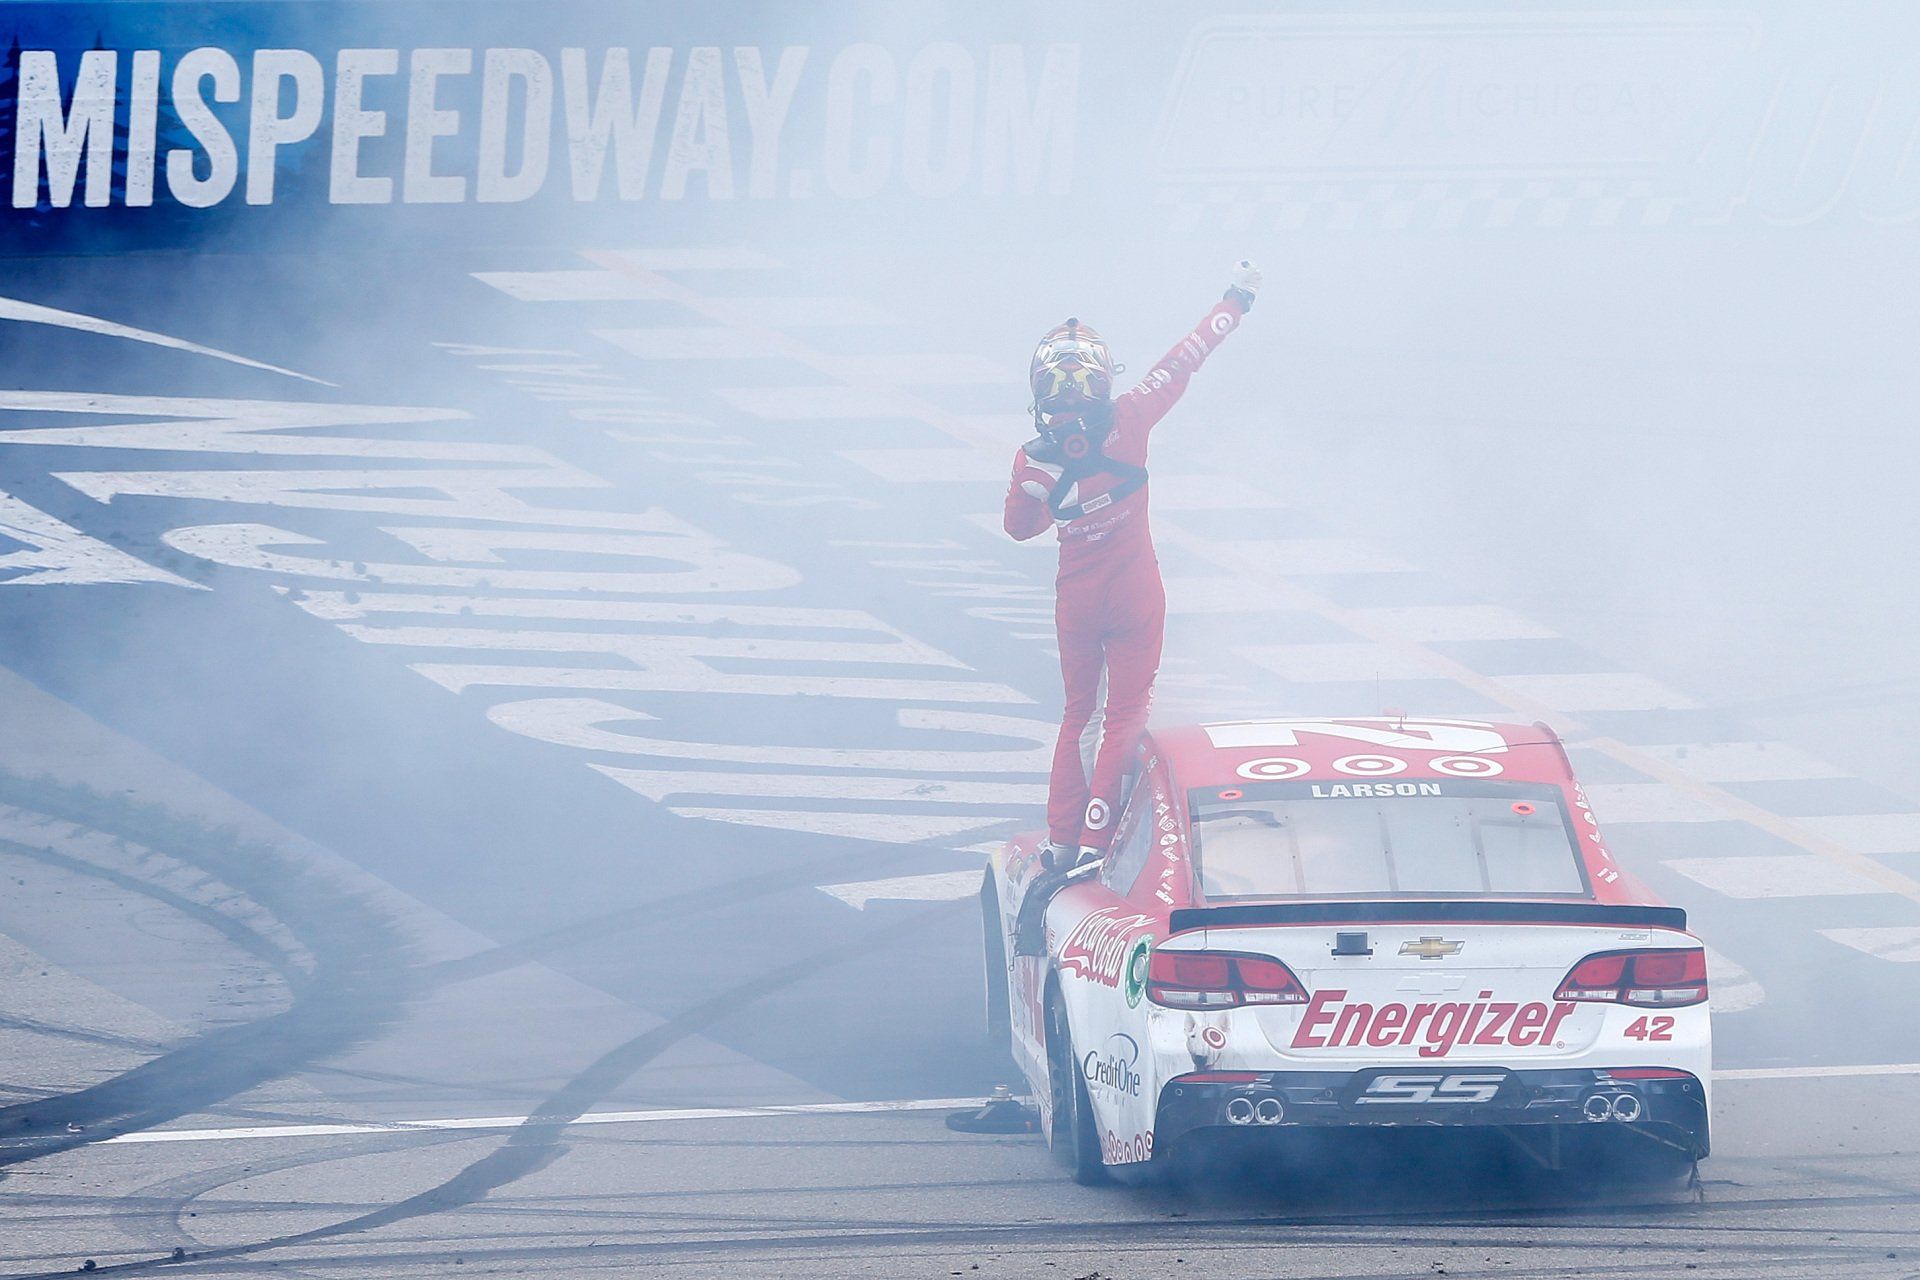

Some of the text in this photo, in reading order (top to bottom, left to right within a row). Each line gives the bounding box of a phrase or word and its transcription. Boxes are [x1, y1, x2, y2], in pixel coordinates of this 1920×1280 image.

[1225, 48, 1679, 142] PURE MICHIGAN
[12, 43, 1080, 208] MISPEEDWAY.COM
[1311, 783, 1442, 798] LARSON
[1291, 990, 1576, 1057] Energizer
[1624, 1016, 1674, 1041] 42
[1355, 1074, 1507, 1105] SS
